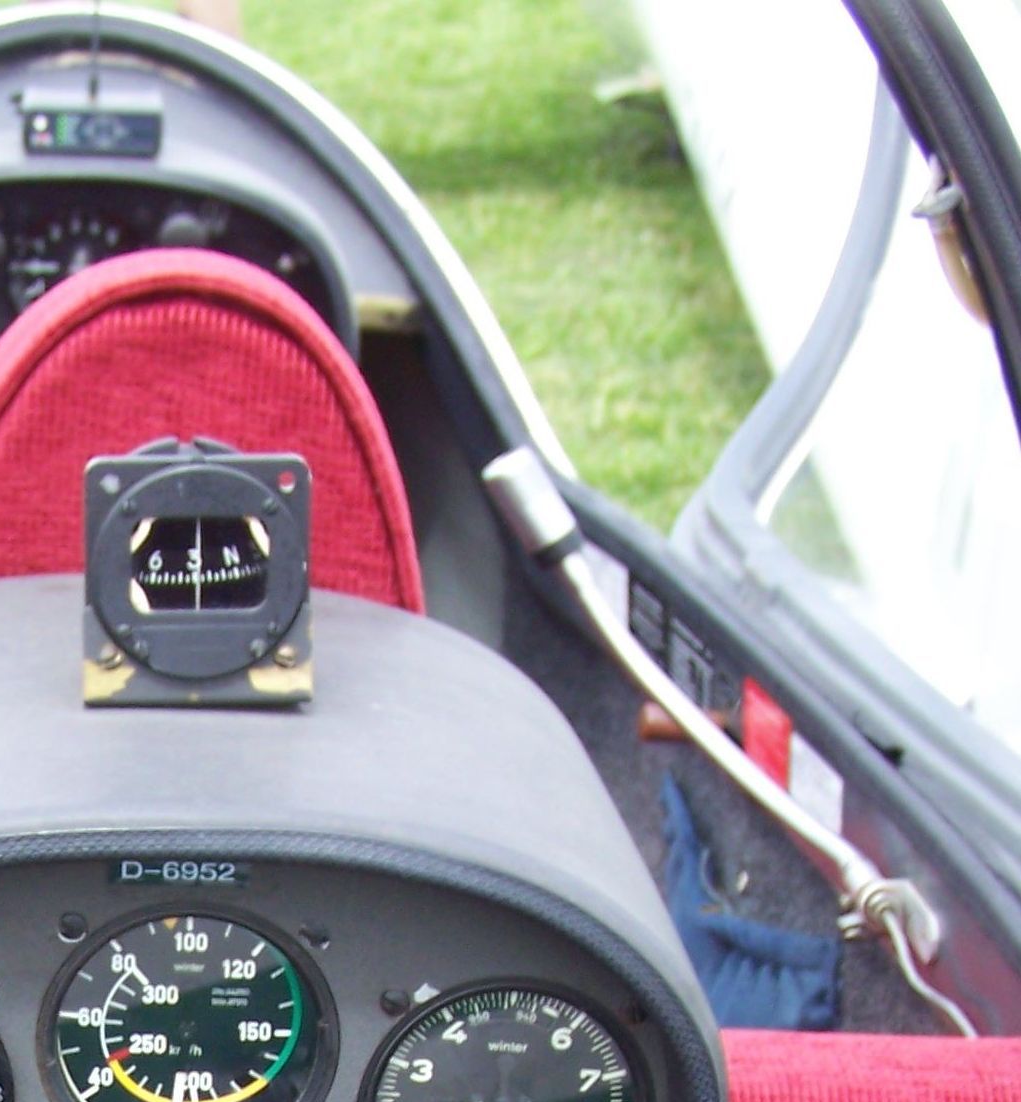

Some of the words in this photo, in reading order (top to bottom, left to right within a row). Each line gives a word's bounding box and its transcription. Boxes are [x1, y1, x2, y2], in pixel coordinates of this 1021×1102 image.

[148, 549, 163, 572] 6
[186, 548, 202, 572] 3
[222, 545, 240, 567] N
[121, 861, 236, 881] D-6952
[174, 932, 208, 953] 100
[111, 953, 136, 973] 80
[222, 958, 256, 979] 120
[141, 984, 179, 1005] 300
[77, 1007, 103, 1027] 60
[238, 1021, 272, 1041] 150
[441, 1021, 468, 1044] 4
[551, 1027, 573, 1050] 6
[129, 1034, 167, 1055] 250
[488, 1041, 528, 1053] winter
[88, 1066, 114, 1087] 40
[410, 1059, 433, 1082] 3
[579, 1069, 601, 1092] 7
